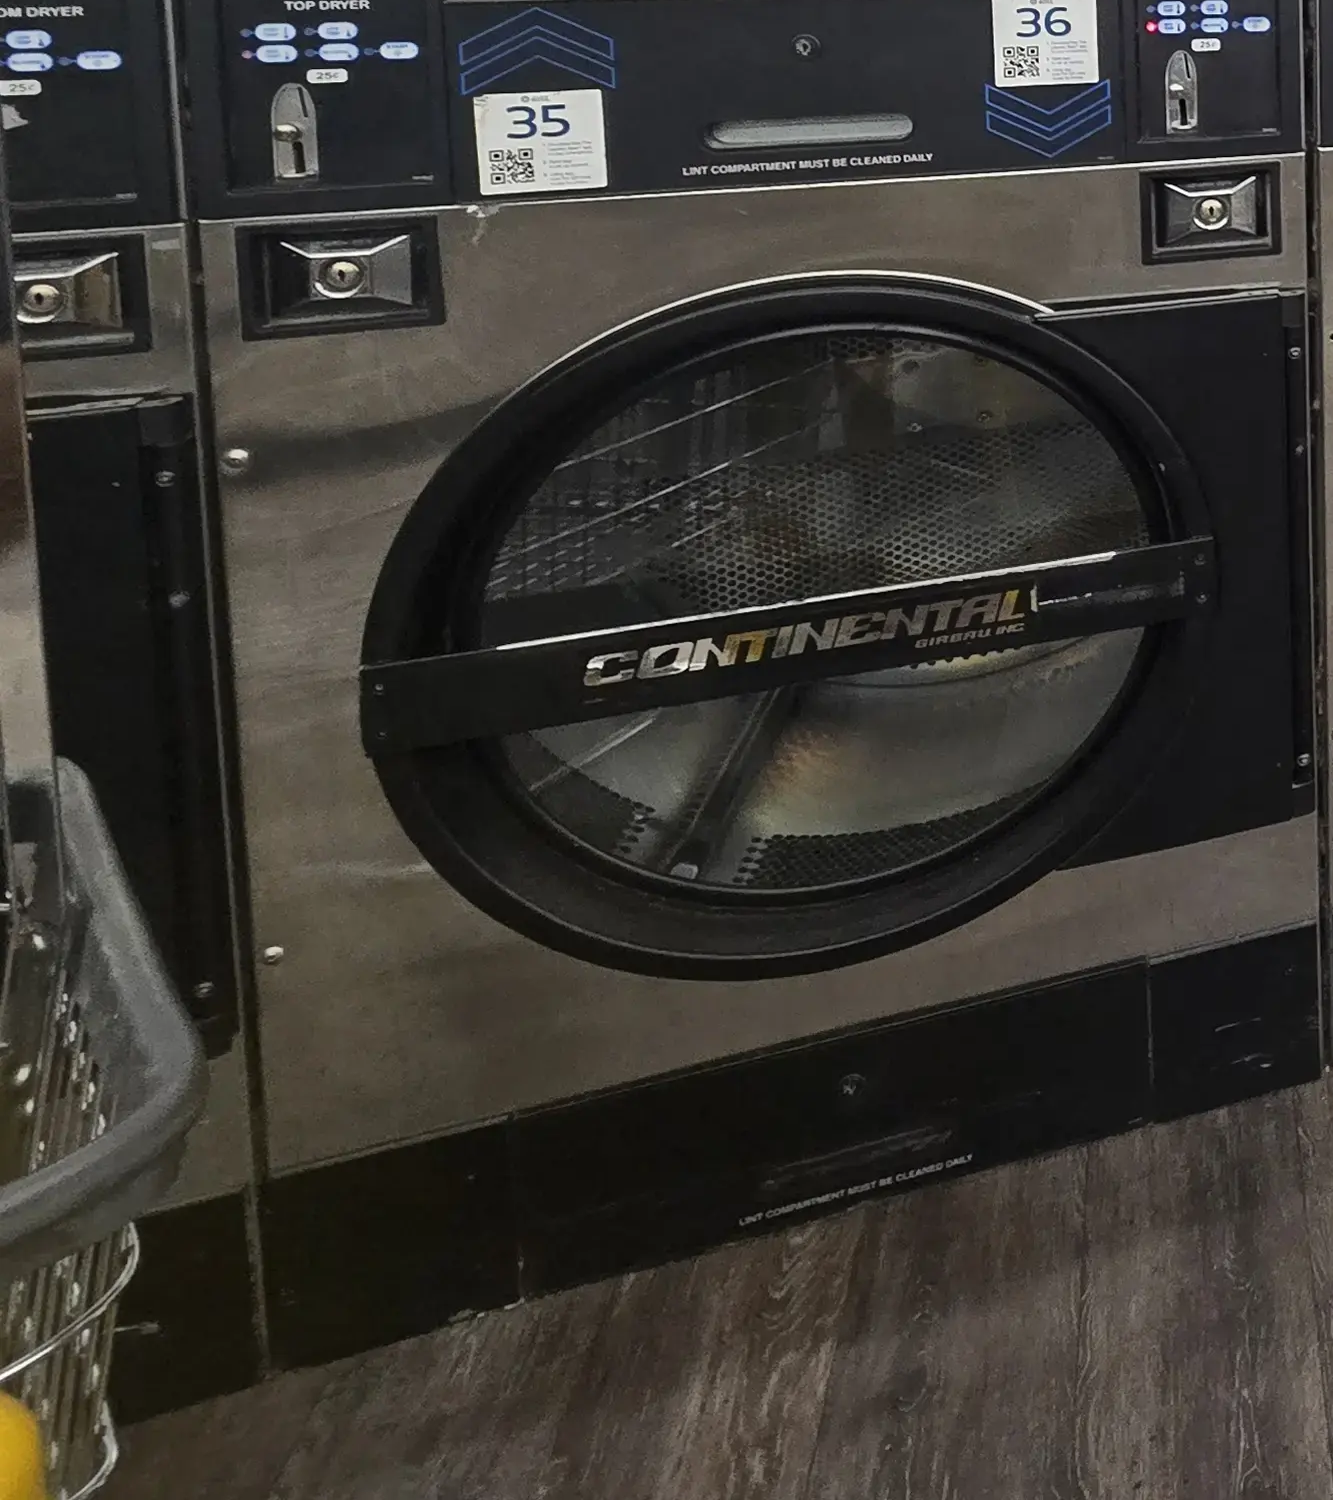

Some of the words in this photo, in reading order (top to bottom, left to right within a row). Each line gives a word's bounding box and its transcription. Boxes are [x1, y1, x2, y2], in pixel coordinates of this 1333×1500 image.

[26, 6, 85, 18] DRYER
[284, 1, 316, 11] TOP
[319, 0, 370, 11] DRYER
[1016, 7, 1071, 37] 36
[506, 104, 570, 139] 35
[682, 166, 708, 176] LINT
[711, 160, 797, 175] COMPARTMENT
[799, 158, 830, 169] MUST
[833, 157, 847, 167] BE
[850, 155, 901, 166] CLEANED
[903, 153, 933, 163] DAILY
[583, 588, 1027, 688] CONTINENTAL
[915, 626, 994, 650] GIRBAU
